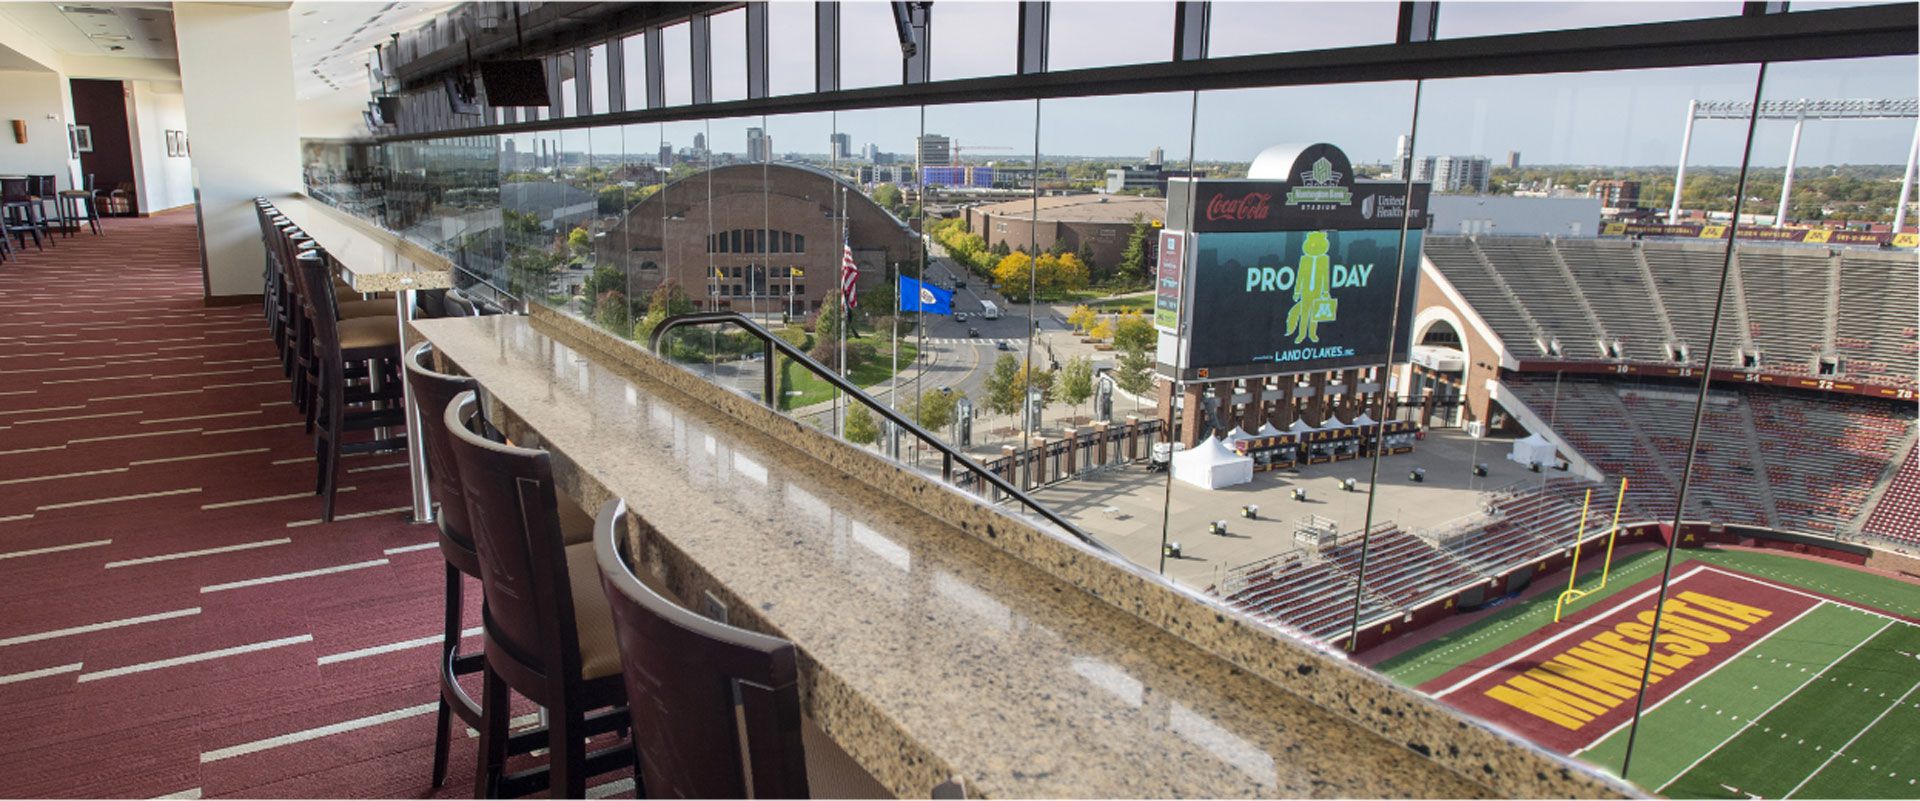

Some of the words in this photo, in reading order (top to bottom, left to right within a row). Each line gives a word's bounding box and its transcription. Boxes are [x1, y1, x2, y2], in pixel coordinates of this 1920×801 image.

[1206, 192, 1272, 221] Coca-Cola
[1378, 195, 1406, 206] United
[1377, 206, 1420, 218] Healthare
[1246, 266, 1295, 292] PRO
[1331, 263, 1375, 288] DAY
[1275, 349, 1301, 362] LAND
[1617, 365, 1629, 373] 10
[1818, 380, 1834, 389] 72
[1897, 389, 1913, 398] 78
[1483, 590, 1773, 731] MINNESOTA
